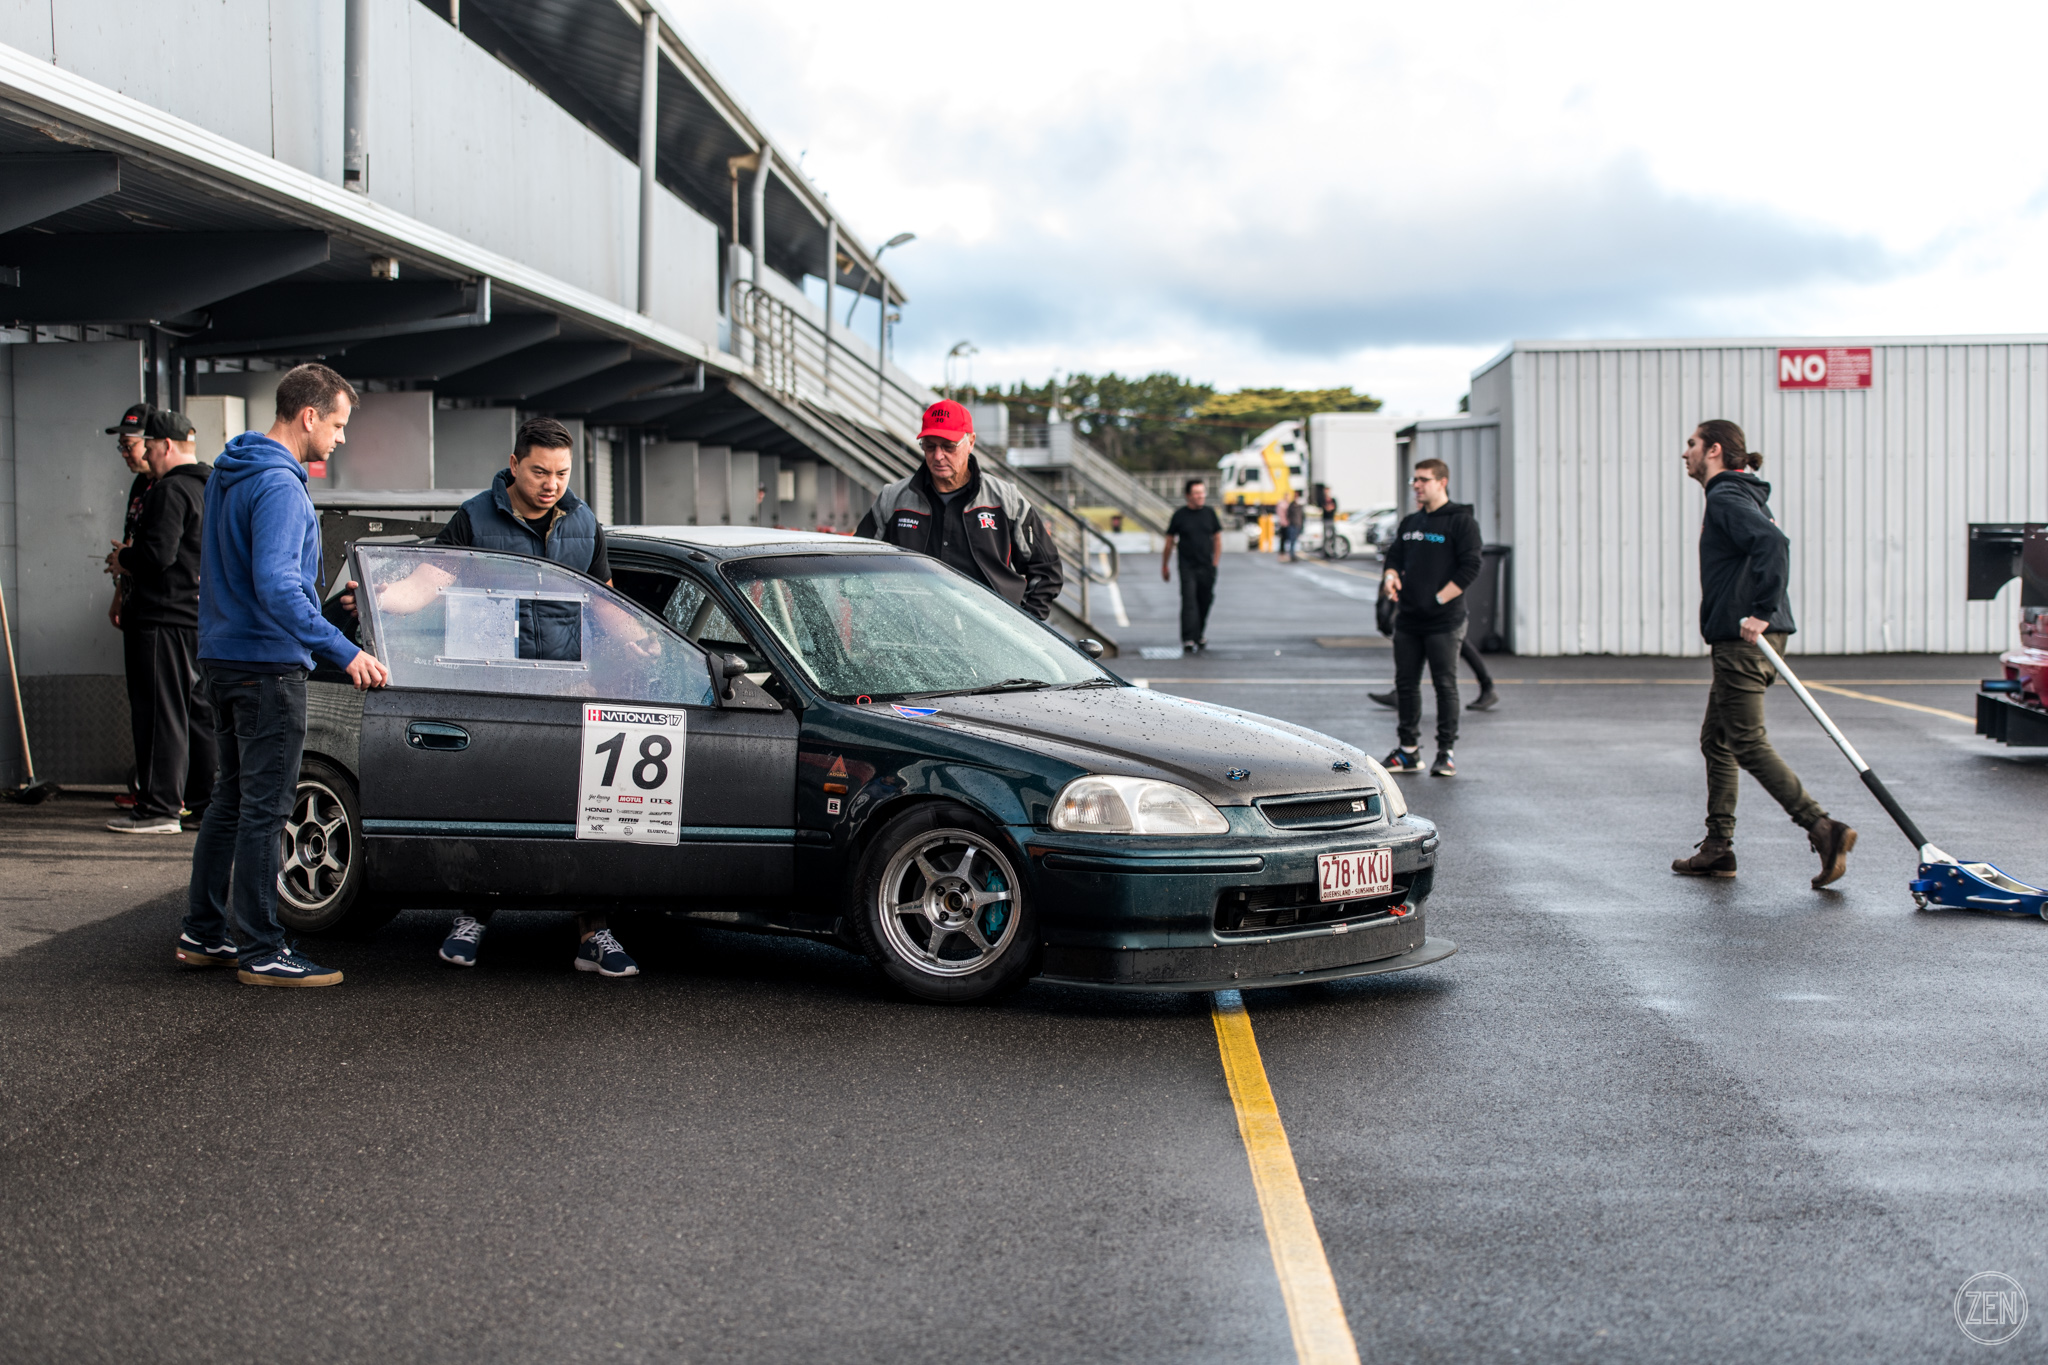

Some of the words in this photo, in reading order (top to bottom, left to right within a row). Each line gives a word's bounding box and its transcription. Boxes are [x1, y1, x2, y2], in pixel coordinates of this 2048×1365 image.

[1780, 354, 1826, 382] NO
[601, 712, 667, 725] NATIONALS
[595, 732, 672, 790] 18
[829, 802, 839, 811] B
[1351, 800, 1366, 812] Si
[1323, 889, 1351, 898] QUEENSLAND
[1355, 885, 1375, 894] SUNSHINE
[1377, 884, 1390, 892] STATE
